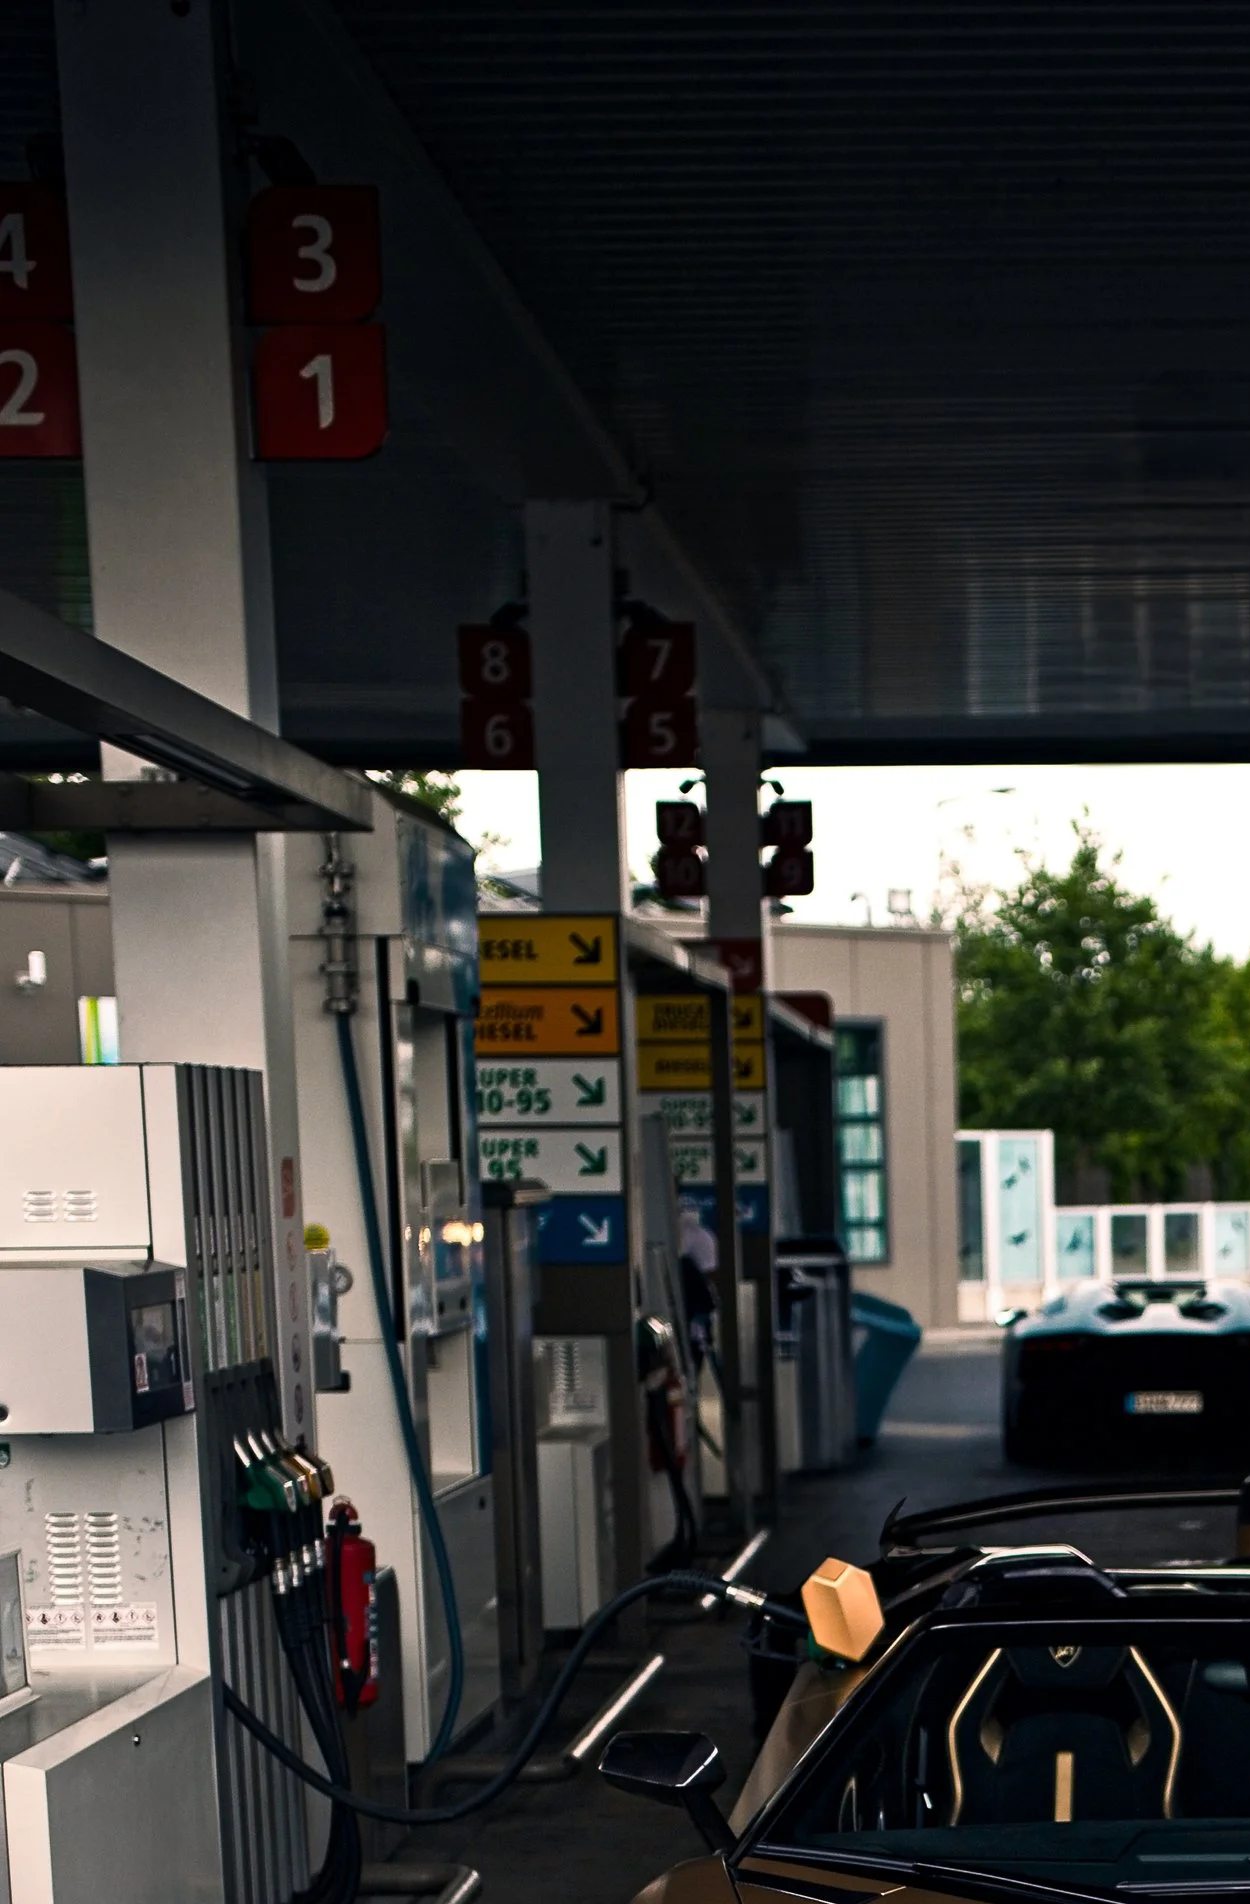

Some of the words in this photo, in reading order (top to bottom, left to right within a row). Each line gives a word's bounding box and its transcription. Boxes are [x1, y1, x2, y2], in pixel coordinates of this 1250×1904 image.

[0, 212, 37, 291] 4
[290, 212, 338, 293] 3
[0, 347, 46, 426] 2
[298, 352, 336, 430] 1
[480, 638, 511, 685] 8
[645, 638, 674, 682] 7
[484, 712, 515, 758] 6
[646, 709, 678, 757] 5
[663, 808, 697, 841] 12
[776, 807, 804, 838] 11
[664, 856, 700, 888] 10
[779, 857, 803, 887] 9
[481, 939, 539, 961] ESEL
[478, 1021, 539, 1042] IESEL
[480, 1068, 537, 1087] UPER
[476, 1087, 552, 1116] 10-95
[481, 1138, 538, 1158] UPER
[487, 1158, 523, 1181] 95
